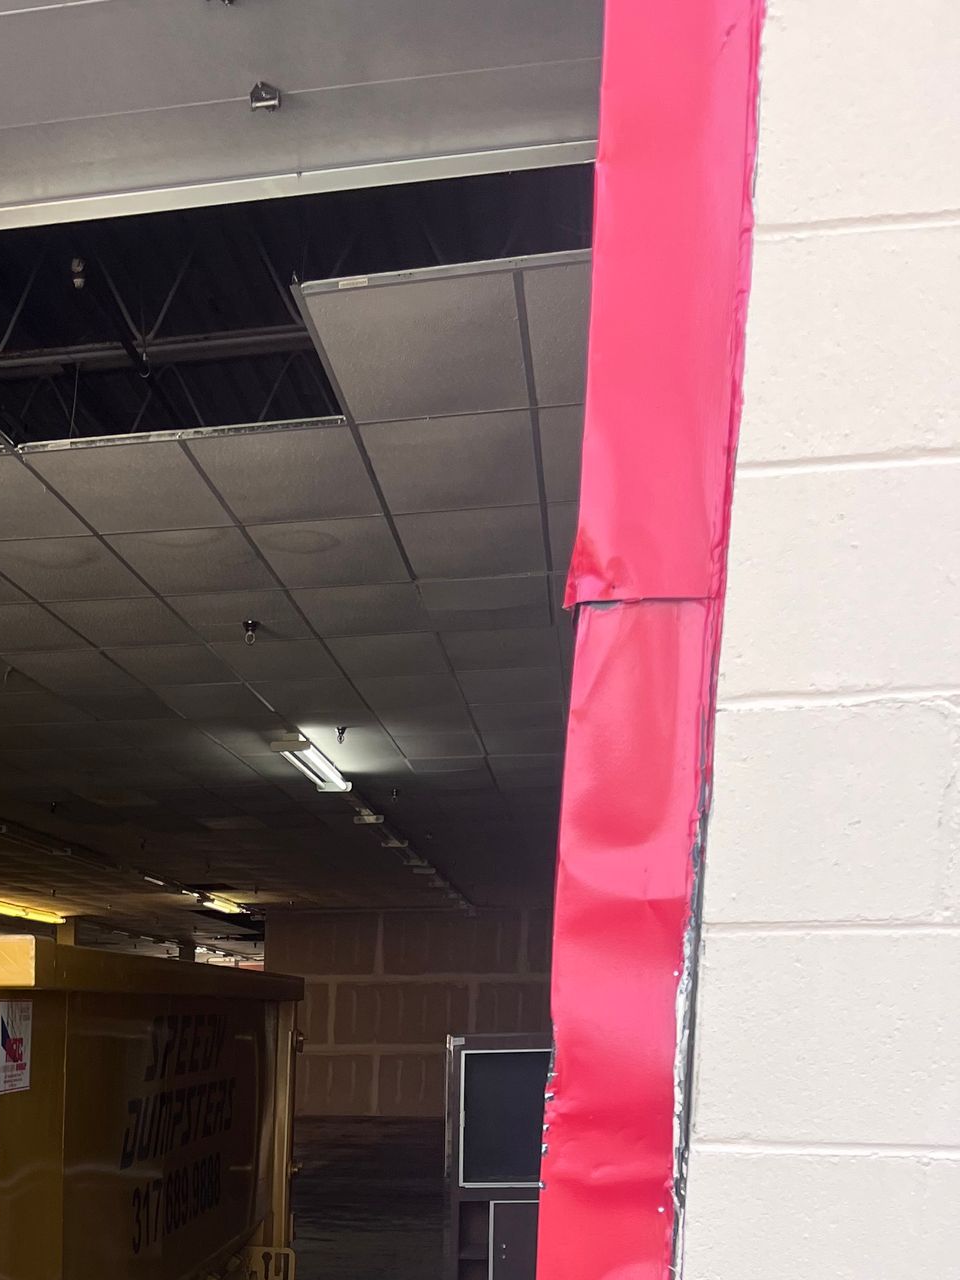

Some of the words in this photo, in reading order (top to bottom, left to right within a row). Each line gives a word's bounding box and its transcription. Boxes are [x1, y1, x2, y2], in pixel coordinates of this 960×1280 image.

[144, 1013, 226, 1081] SPEEDY
[120, 1077, 237, 1169] DUMPSTERS
[132, 1152, 222, 1255] 317.689.9888
